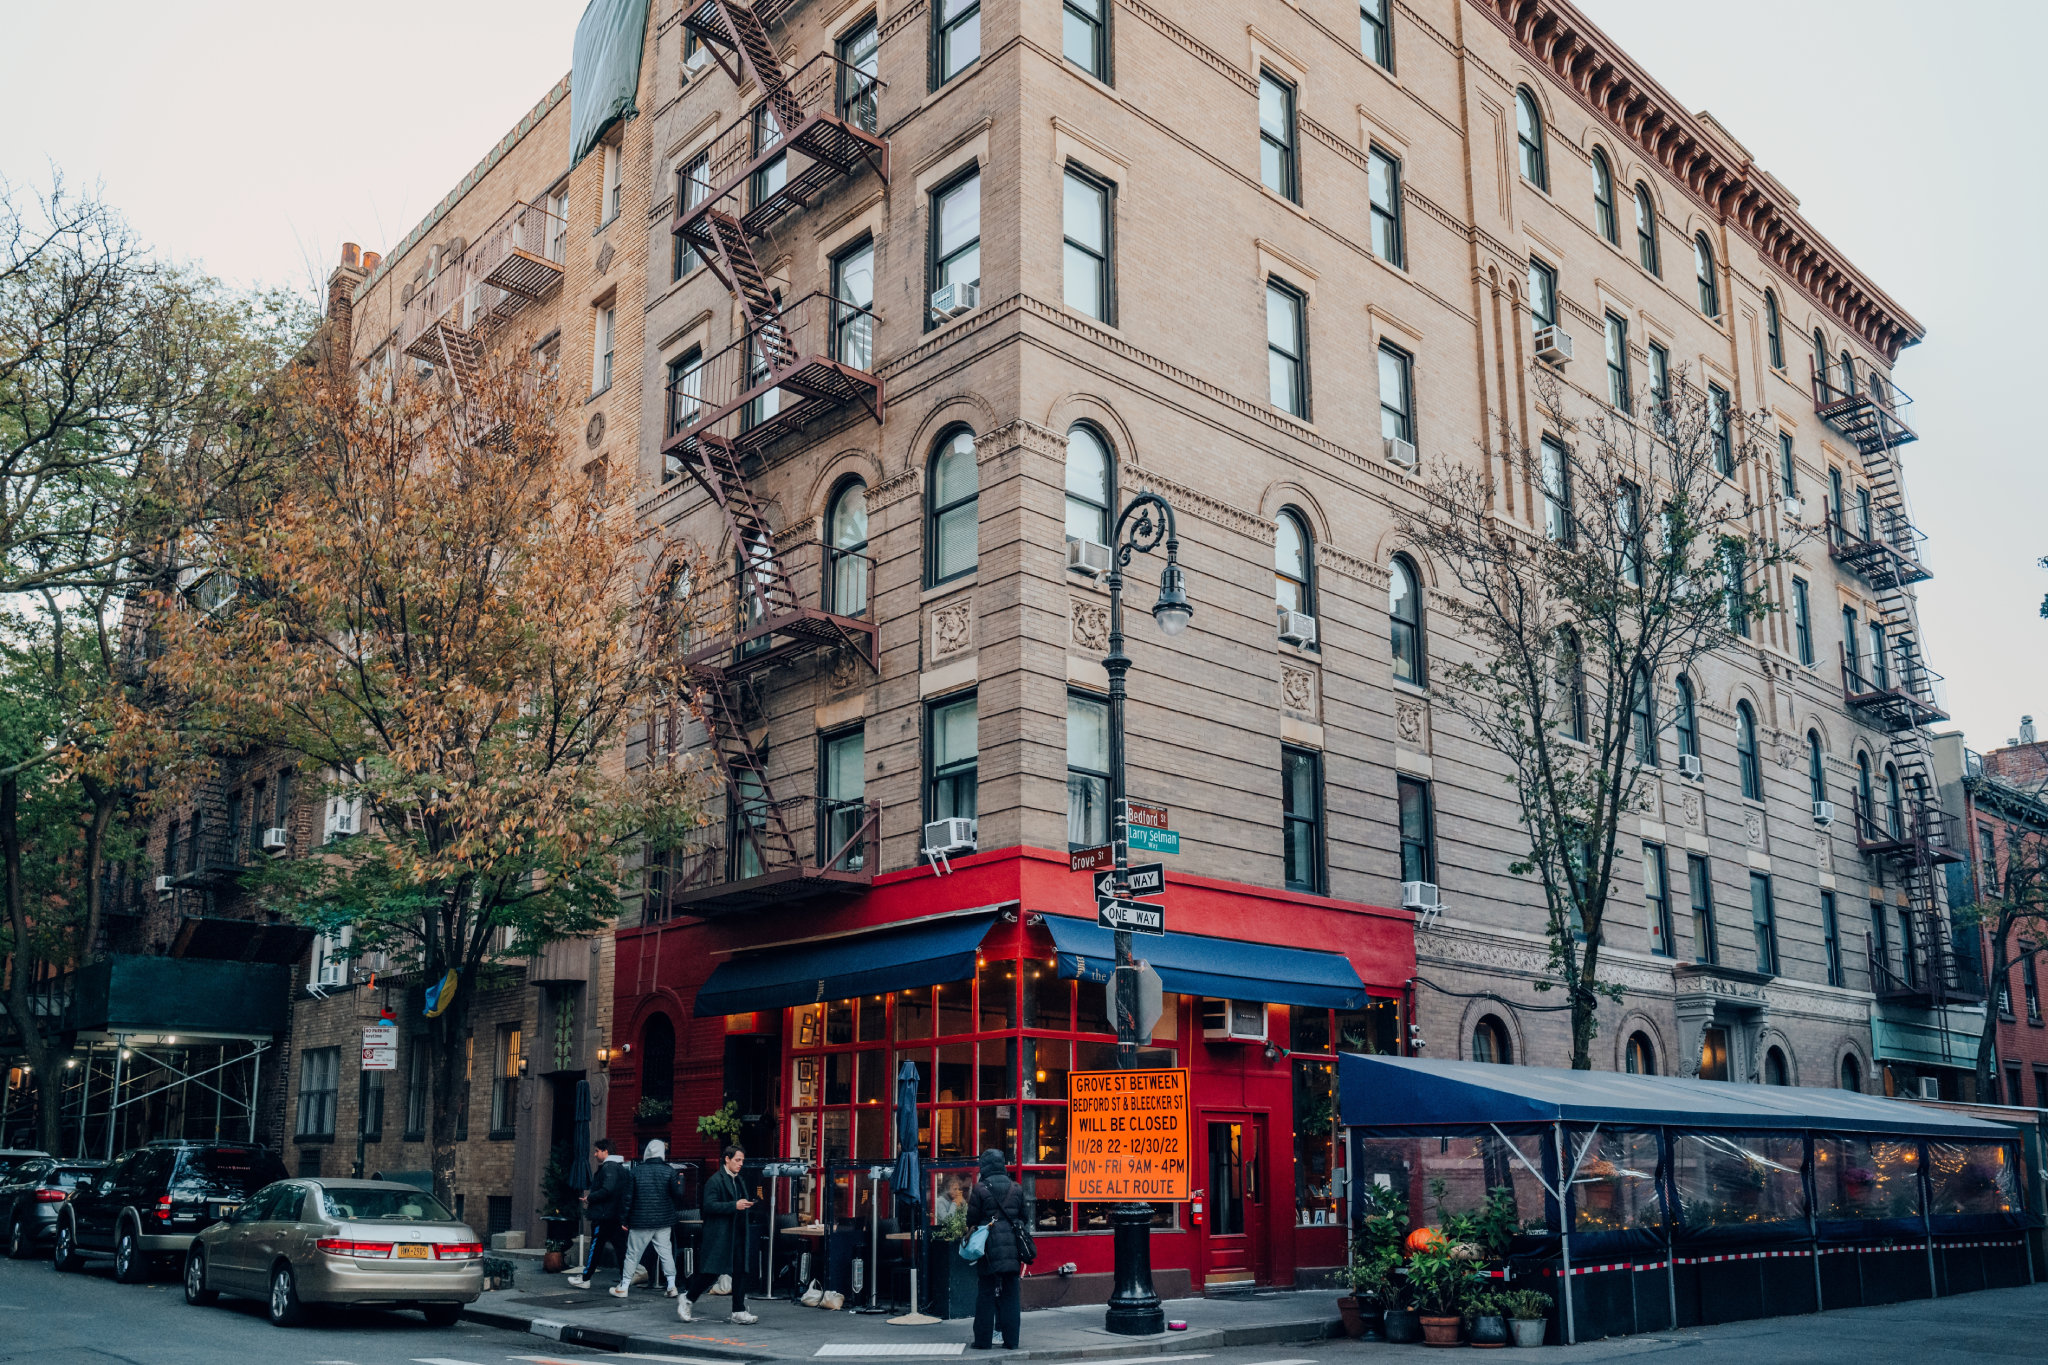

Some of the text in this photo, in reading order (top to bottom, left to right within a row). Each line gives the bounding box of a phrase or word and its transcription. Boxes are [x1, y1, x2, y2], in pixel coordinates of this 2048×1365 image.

[1128, 807, 1167, 826] Bedford St
[1129, 827, 1177, 845] Larry Selman
[1148, 842, 1158, 850] Way
[1072, 851, 1104, 870] Grove St
[1133, 873, 1155, 887] WAY
[1108, 907, 1156, 925] ONE WAY
[1092, 968, 1107, 981] the
[1077, 1075, 1179, 1092] GROVE ST BETWEEN
[1073, 1095, 1183, 1112] BEDFORD ST & BLEECKER ST
[1080, 1116, 1177, 1132] WILL BE CLOSED
[1078, 1138, 1102, 1155] 11/28
[1108, 1139, 1120, 1153] 22
[1131, 1137, 1178, 1154] 12/30/22
[1073, 1160, 1095, 1174] MON
[1105, 1159, 1121, 1173] FRI
[1129, 1159, 1151, 1173] 9AM
[1161, 1159, 1184, 1173] 4PM
[1080, 1180, 1173, 1194] USE ALT ROUTE
[1316, 1212, 1323, 1225] A
